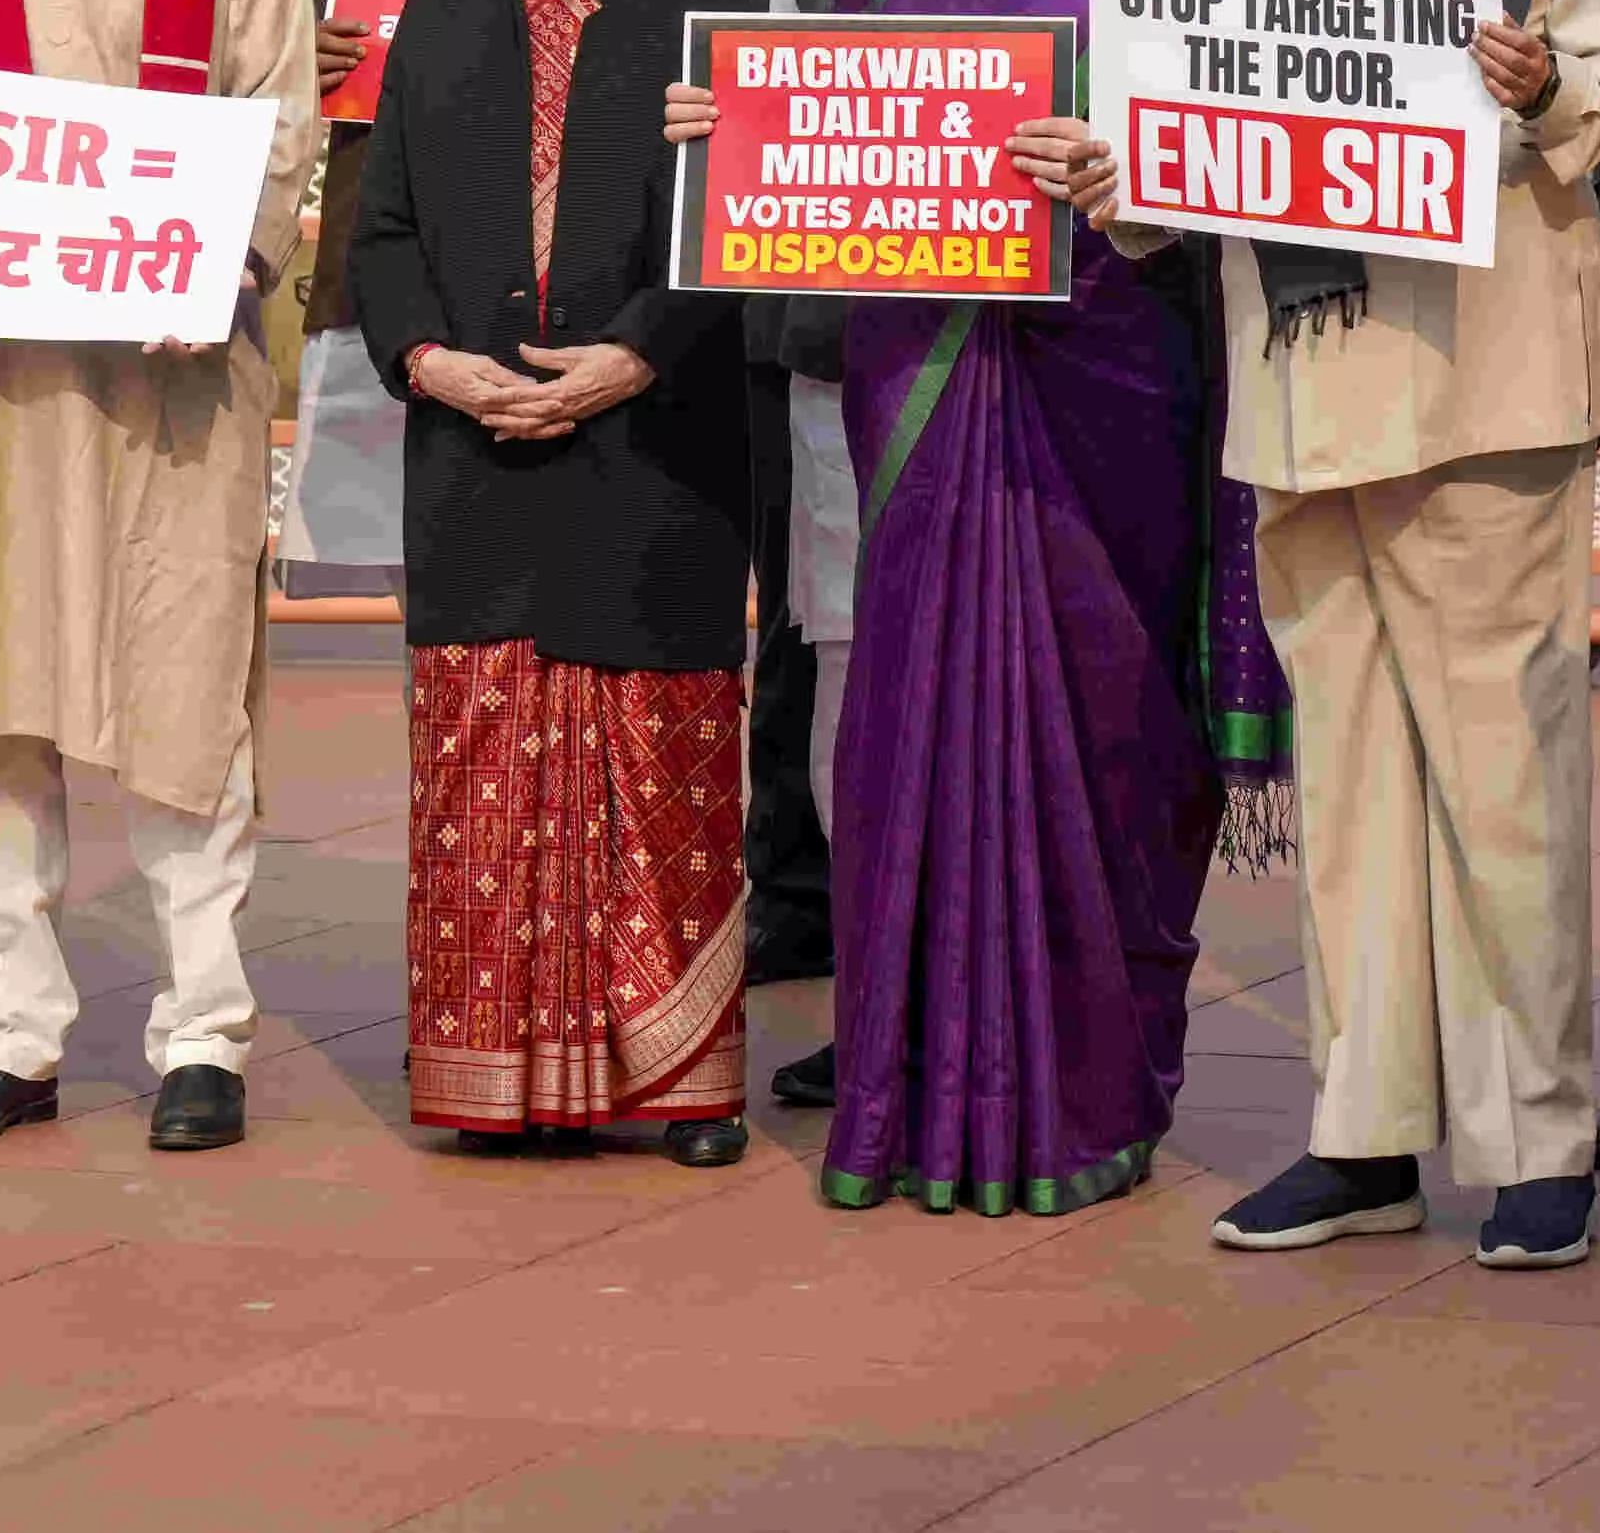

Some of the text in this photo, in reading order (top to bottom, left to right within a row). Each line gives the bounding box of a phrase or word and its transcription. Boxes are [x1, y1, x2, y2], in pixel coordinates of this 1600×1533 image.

[736, 46, 1026, 96] BACKWARD,
[1184, 35, 1407, 110] THE POOR.
[788, 95, 973, 140] DALIT &
[130, 148, 177, 179] =
[761, 144, 999, 187] MINORITY
[1138, 107, 1454, 235] END SIR
[723, 194, 1032, 233] VOTES ARE NOT
[56, 215, 203, 294] चोरी
[721, 232, 1032, 279] DISPOSABLE
